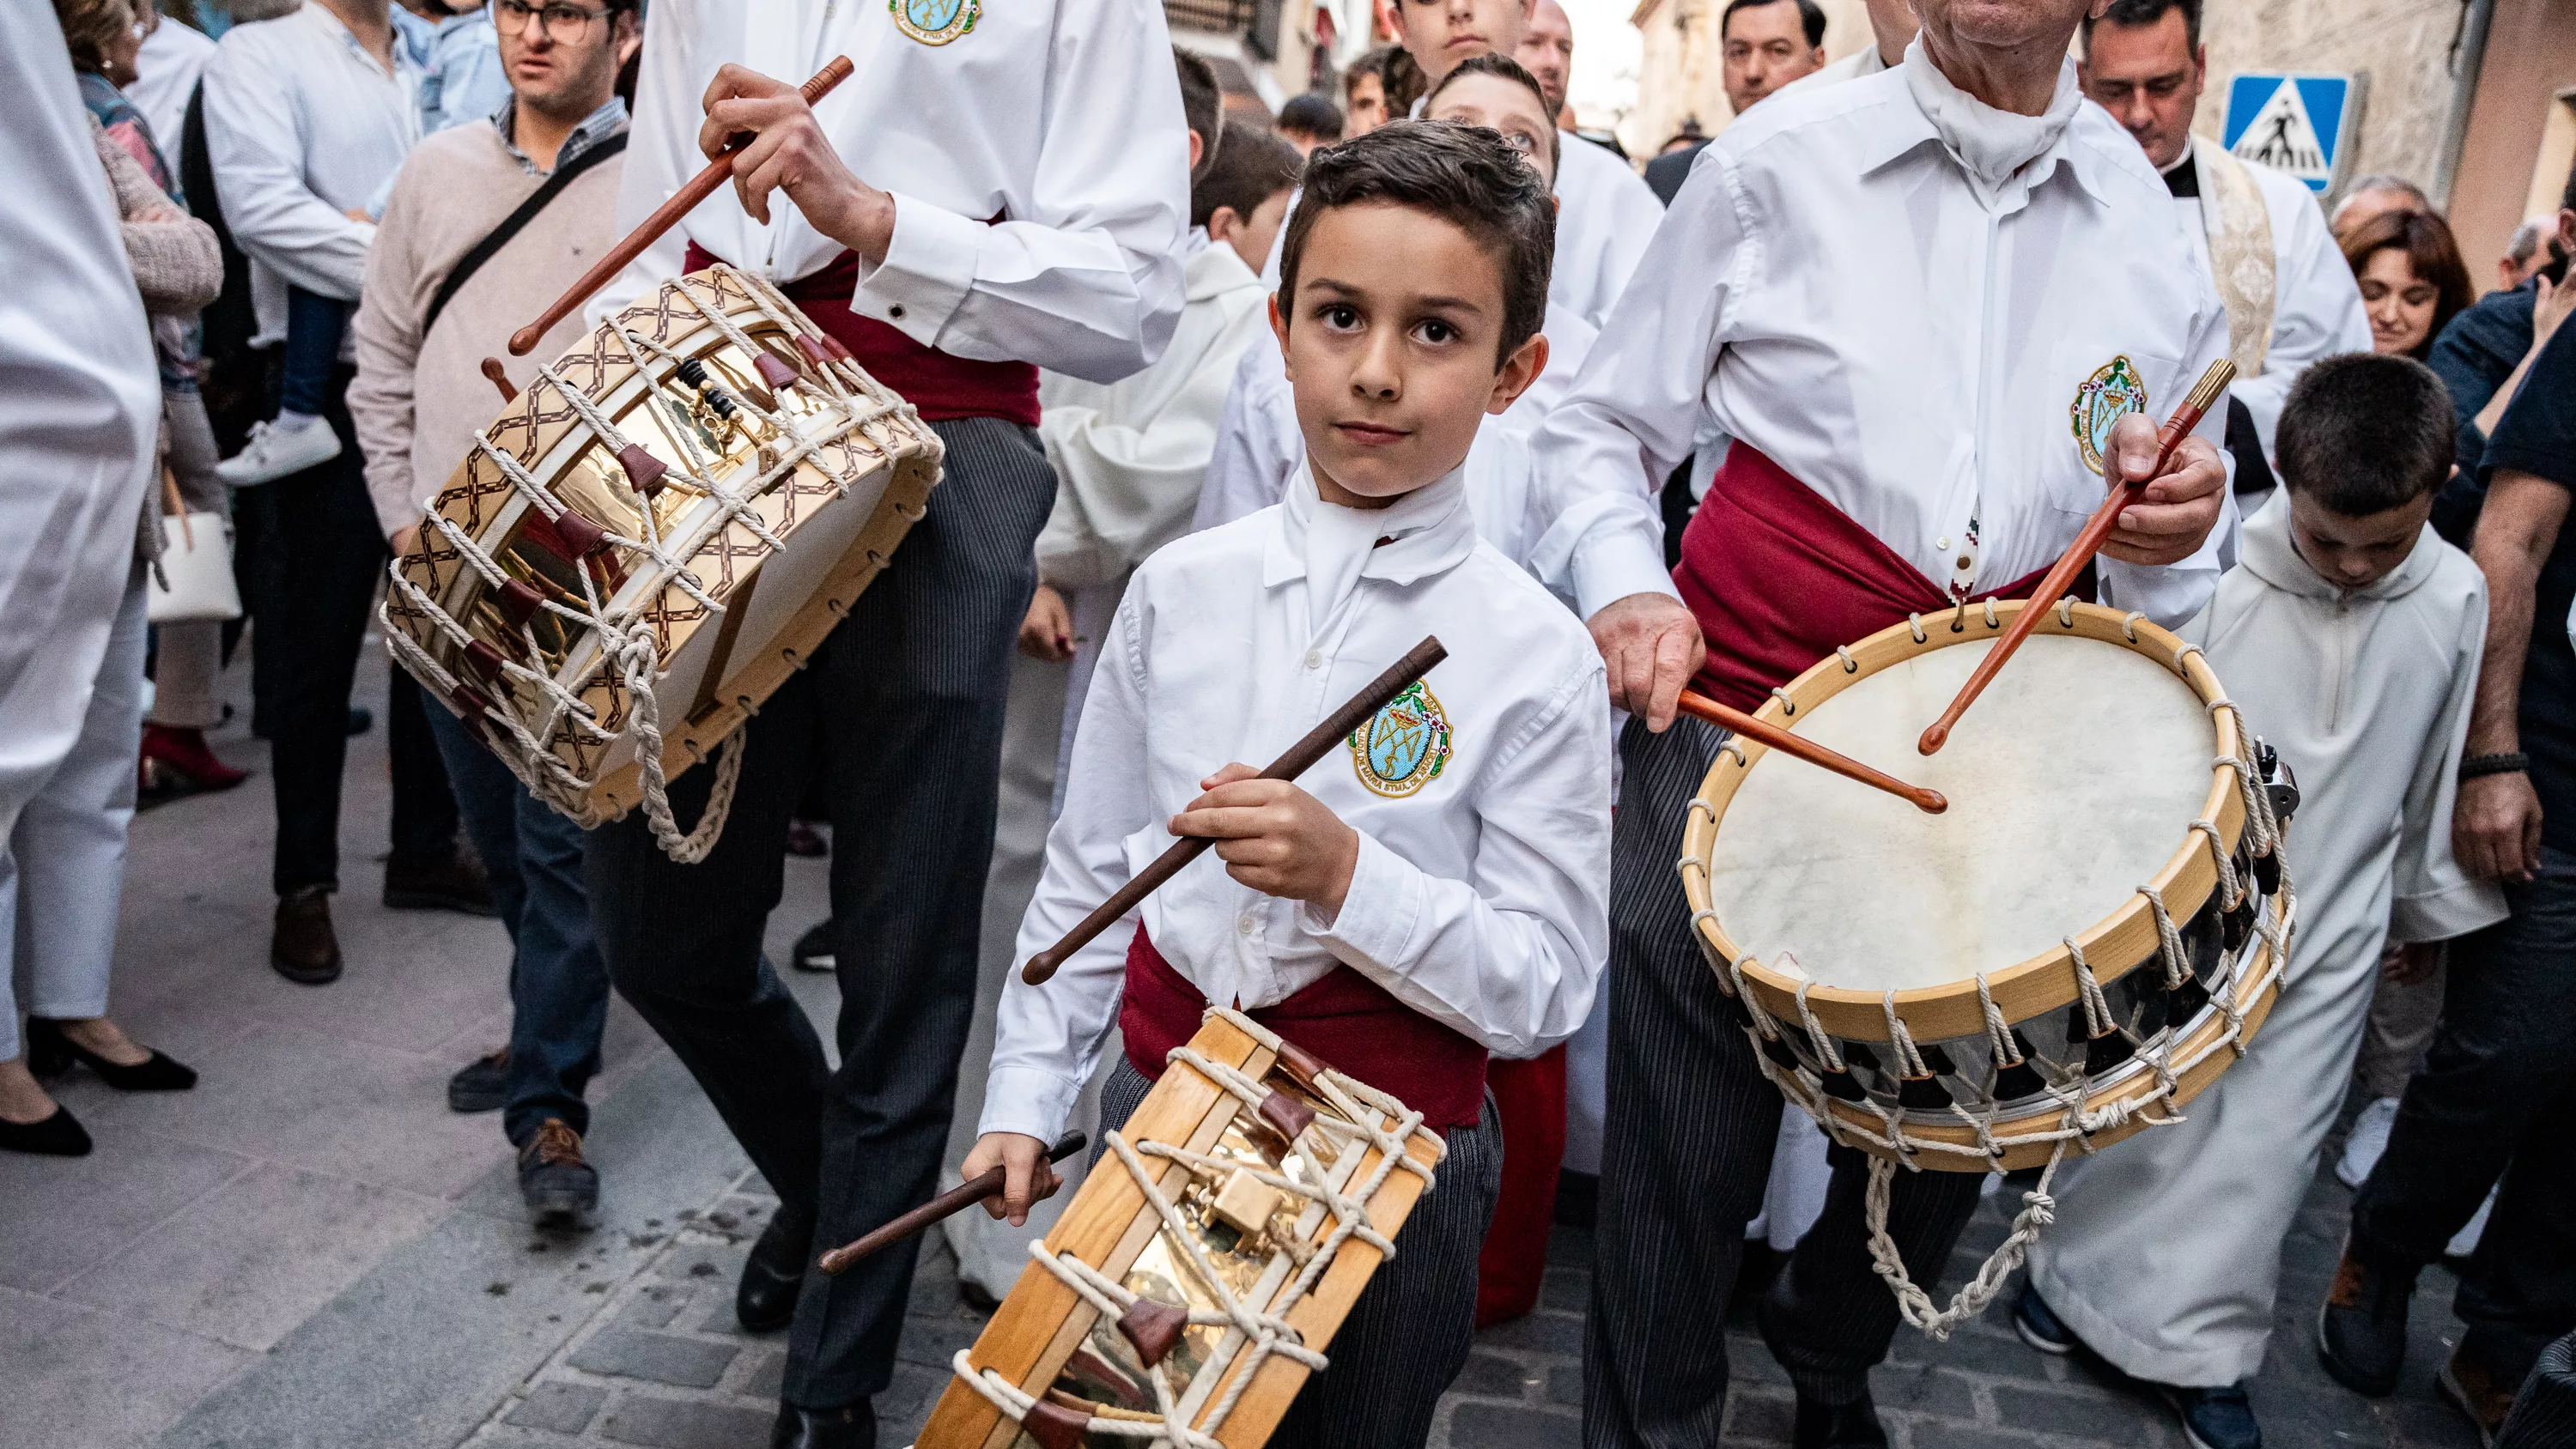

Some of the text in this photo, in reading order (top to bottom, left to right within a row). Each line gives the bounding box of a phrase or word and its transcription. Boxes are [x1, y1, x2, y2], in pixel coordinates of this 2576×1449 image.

[2087, 451, 2103, 468] MARI
[1419, 696, 1440, 716] 2024
[1358, 755, 1365, 766] DE
[1419, 748, 1438, 778] ARACELI
[1361, 767, 1382, 789] MARIA
[1409, 775, 1421, 787] DE
